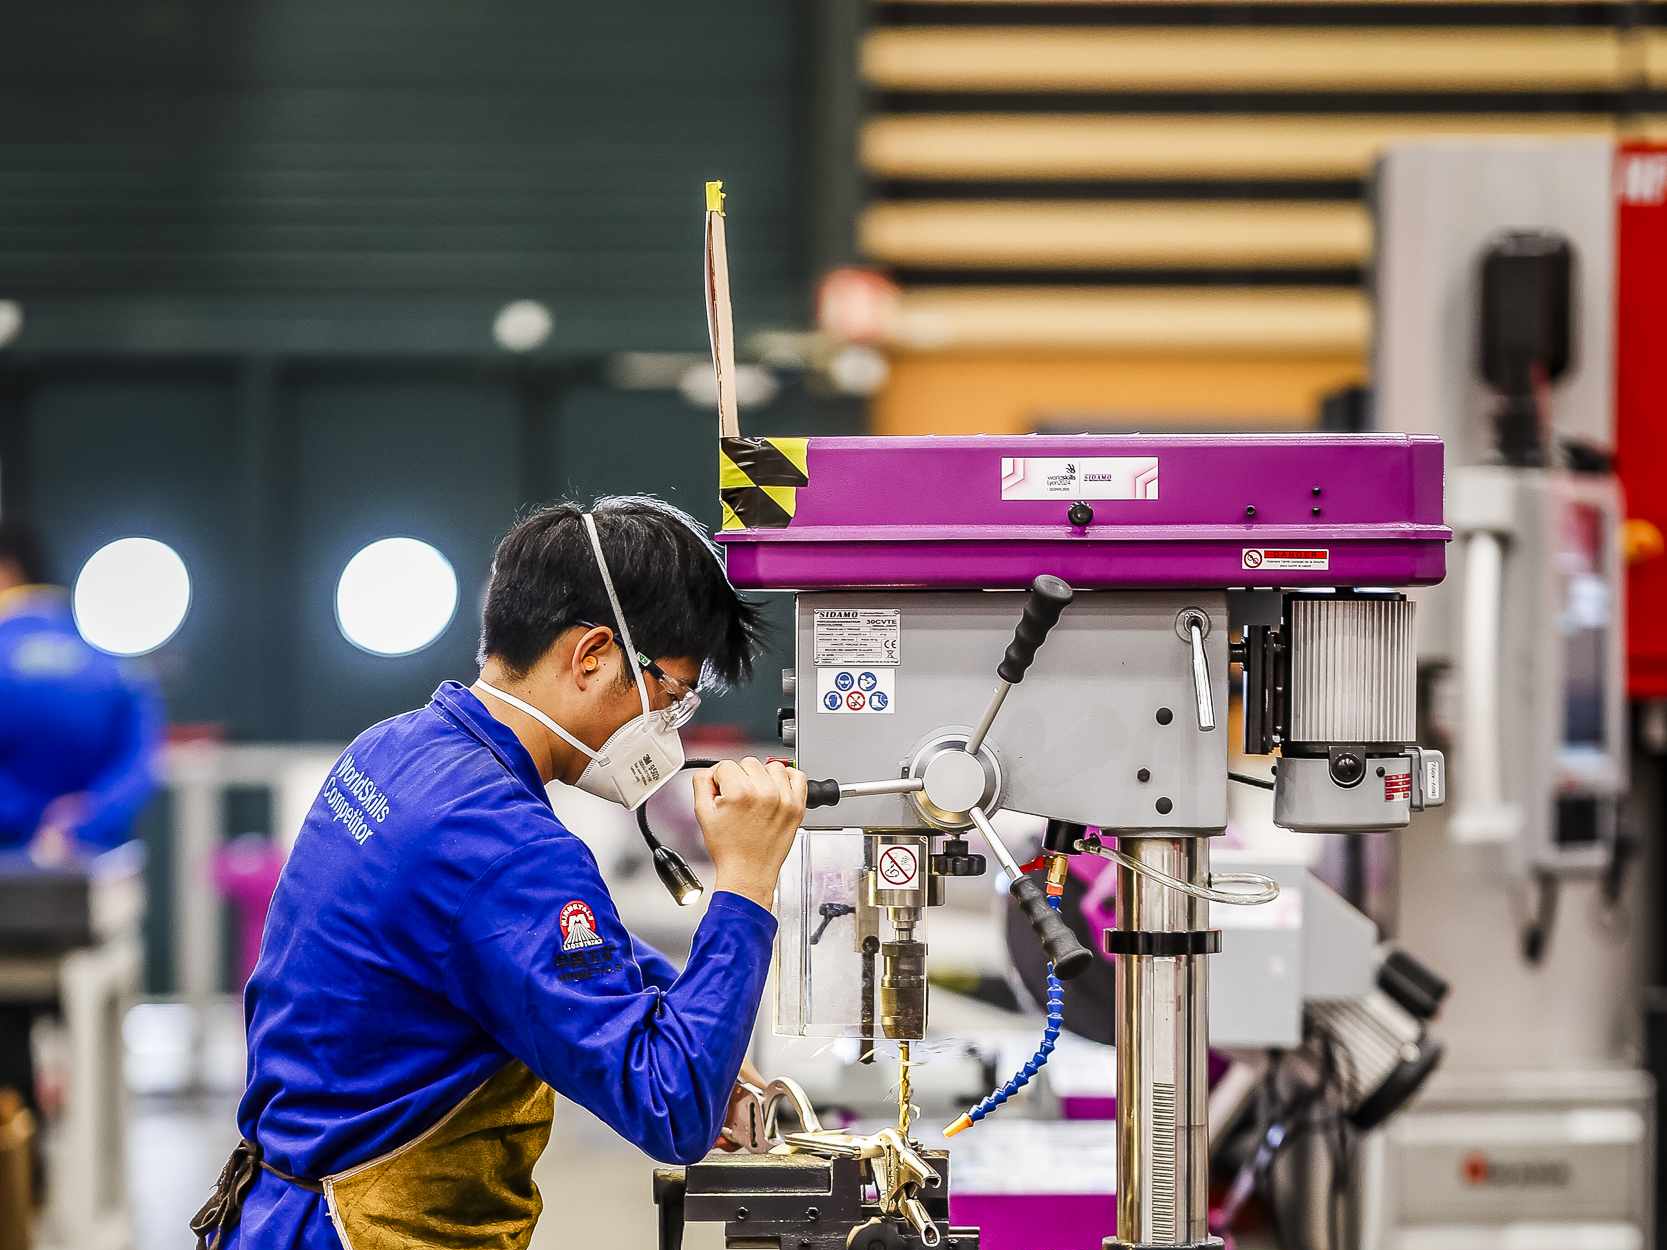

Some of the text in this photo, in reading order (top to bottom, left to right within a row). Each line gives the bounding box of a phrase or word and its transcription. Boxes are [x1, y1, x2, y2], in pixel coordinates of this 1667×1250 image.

[642, 753, 653, 765] 3M
[335, 752, 390, 823] WorldSkills
[323, 776, 374, 846] Competitor
[561, 903, 594, 927] MINMETALS
[557, 962, 623, 982] MINMETALS
